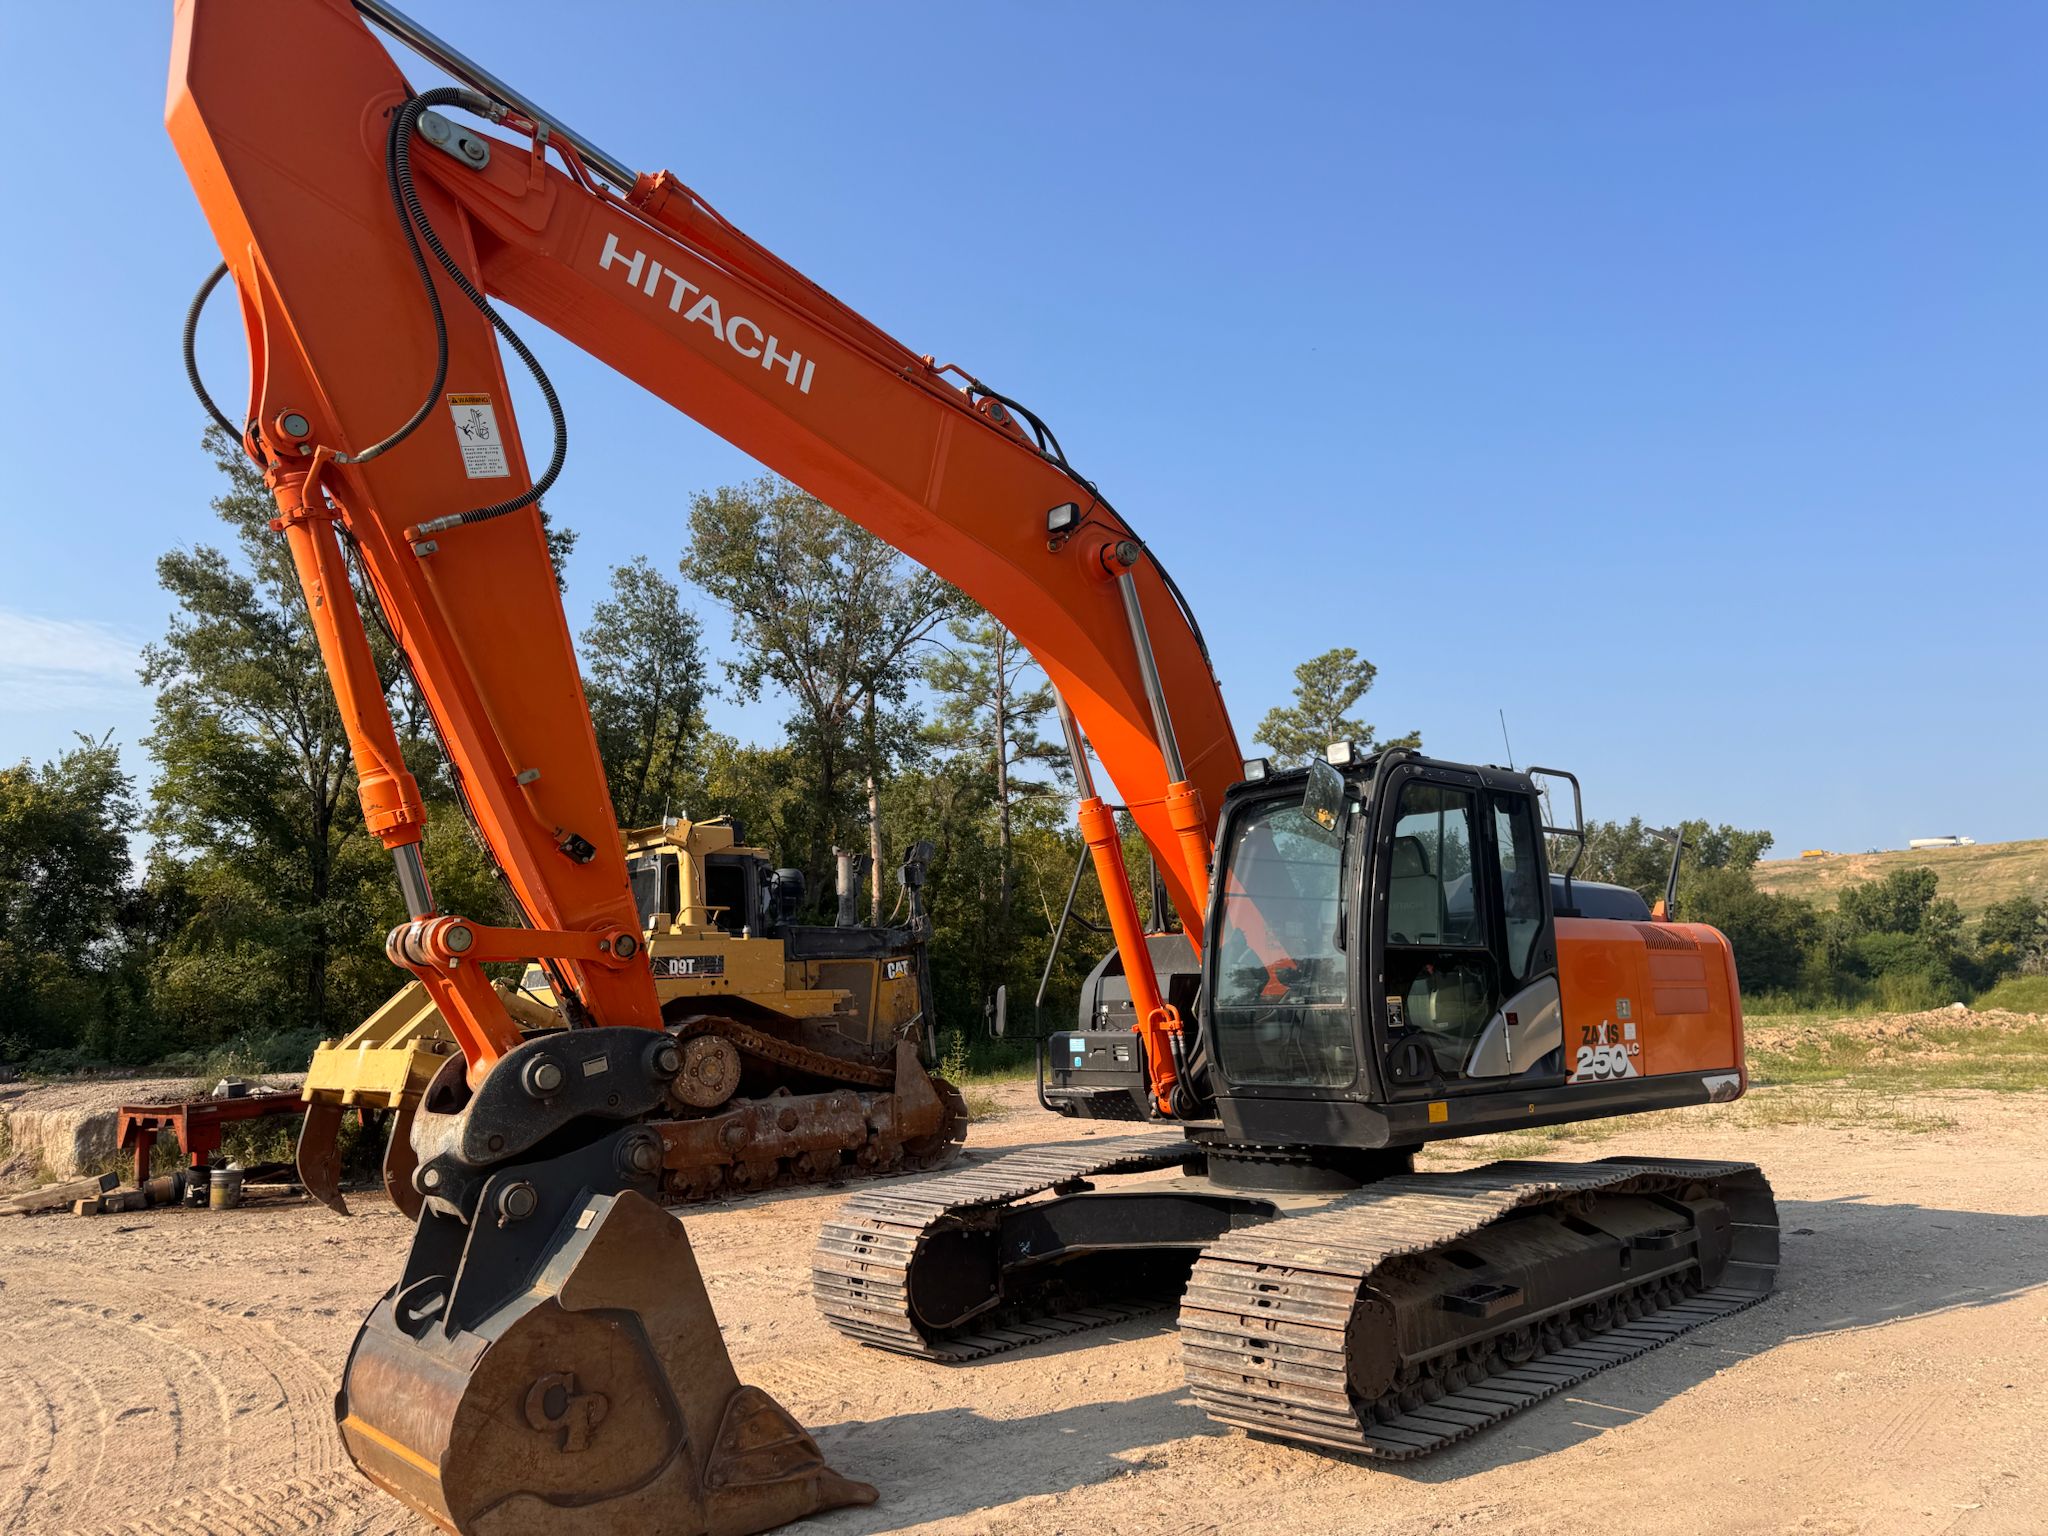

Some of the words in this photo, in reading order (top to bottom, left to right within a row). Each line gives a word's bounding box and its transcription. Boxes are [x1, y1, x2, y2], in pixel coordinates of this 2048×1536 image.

[599, 233, 816, 395] HITACHI
[669, 959, 695, 974] D9T
[887, 960, 909, 979] CAT
[1581, 1019, 1619, 1045] ZAXIS
[1576, 1044, 1628, 1080] 250
